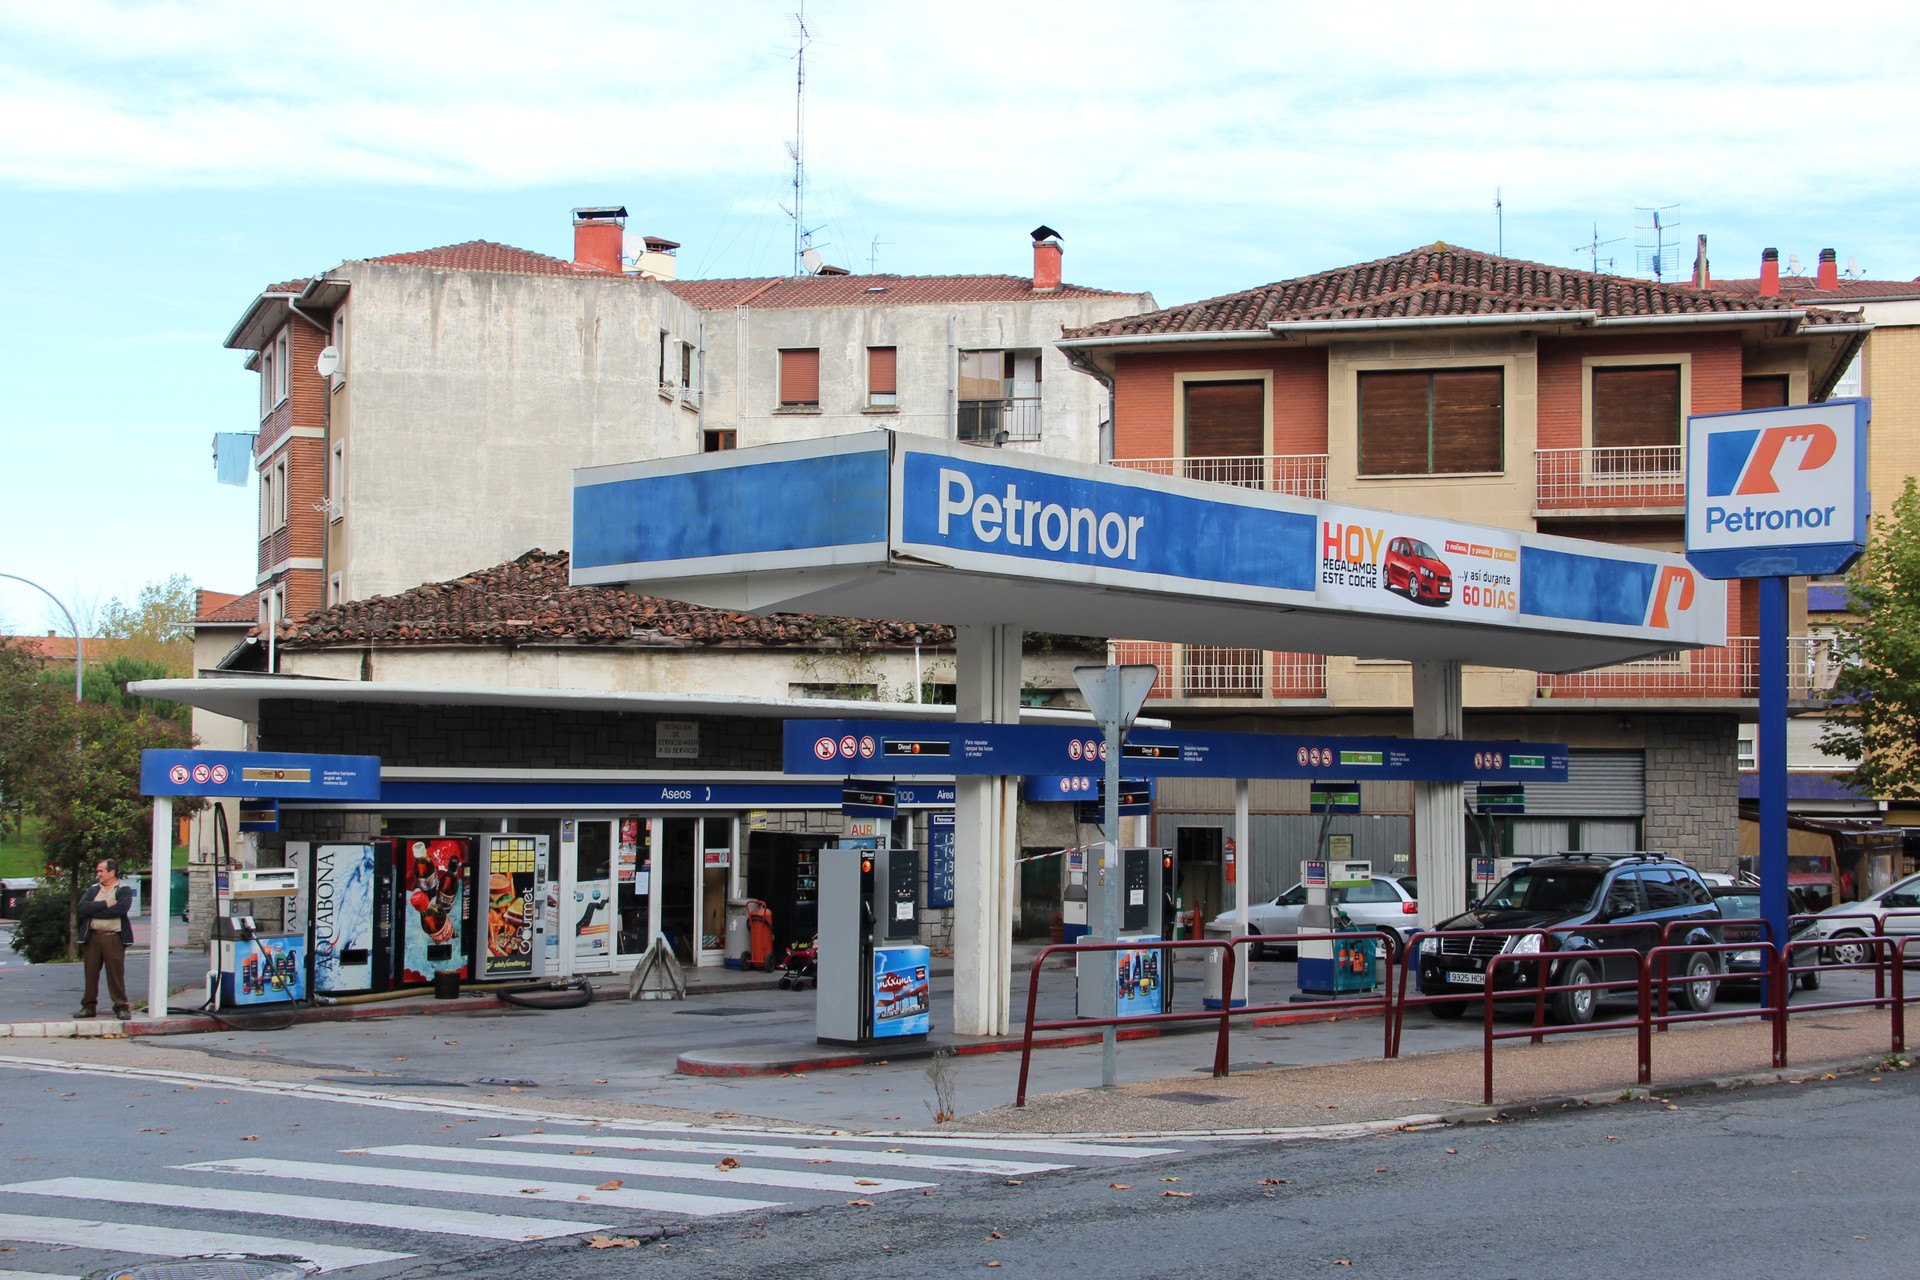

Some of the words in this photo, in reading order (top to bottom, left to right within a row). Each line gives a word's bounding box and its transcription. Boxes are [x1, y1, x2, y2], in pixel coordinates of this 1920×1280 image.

[938, 467, 1145, 560] Petronor
[1706, 504, 1836, 533] Petronor
[1323, 521, 1385, 565] HOY
[1322, 558, 1377, 575] REGALAMOS
[1322, 572, 1344, 585] ESTE
[1348, 574, 1377, 588] COCHE
[1470, 569, 1481, 581] así
[1483, 571, 1511, 585] durante
[1463, 585, 1480, 606] 60
[1483, 583, 1516, 611] DÍAS
[661, 787, 691, 799] Aseos
[936, 789, 954, 799] Airea
[231, 901, 239, 913] 8
[316, 852, 335, 971] AQUABONA
[877, 974, 914, 990] máxima
[1451, 973, 1469, 982] 9325
[1471, 974, 1485, 983] HCH
